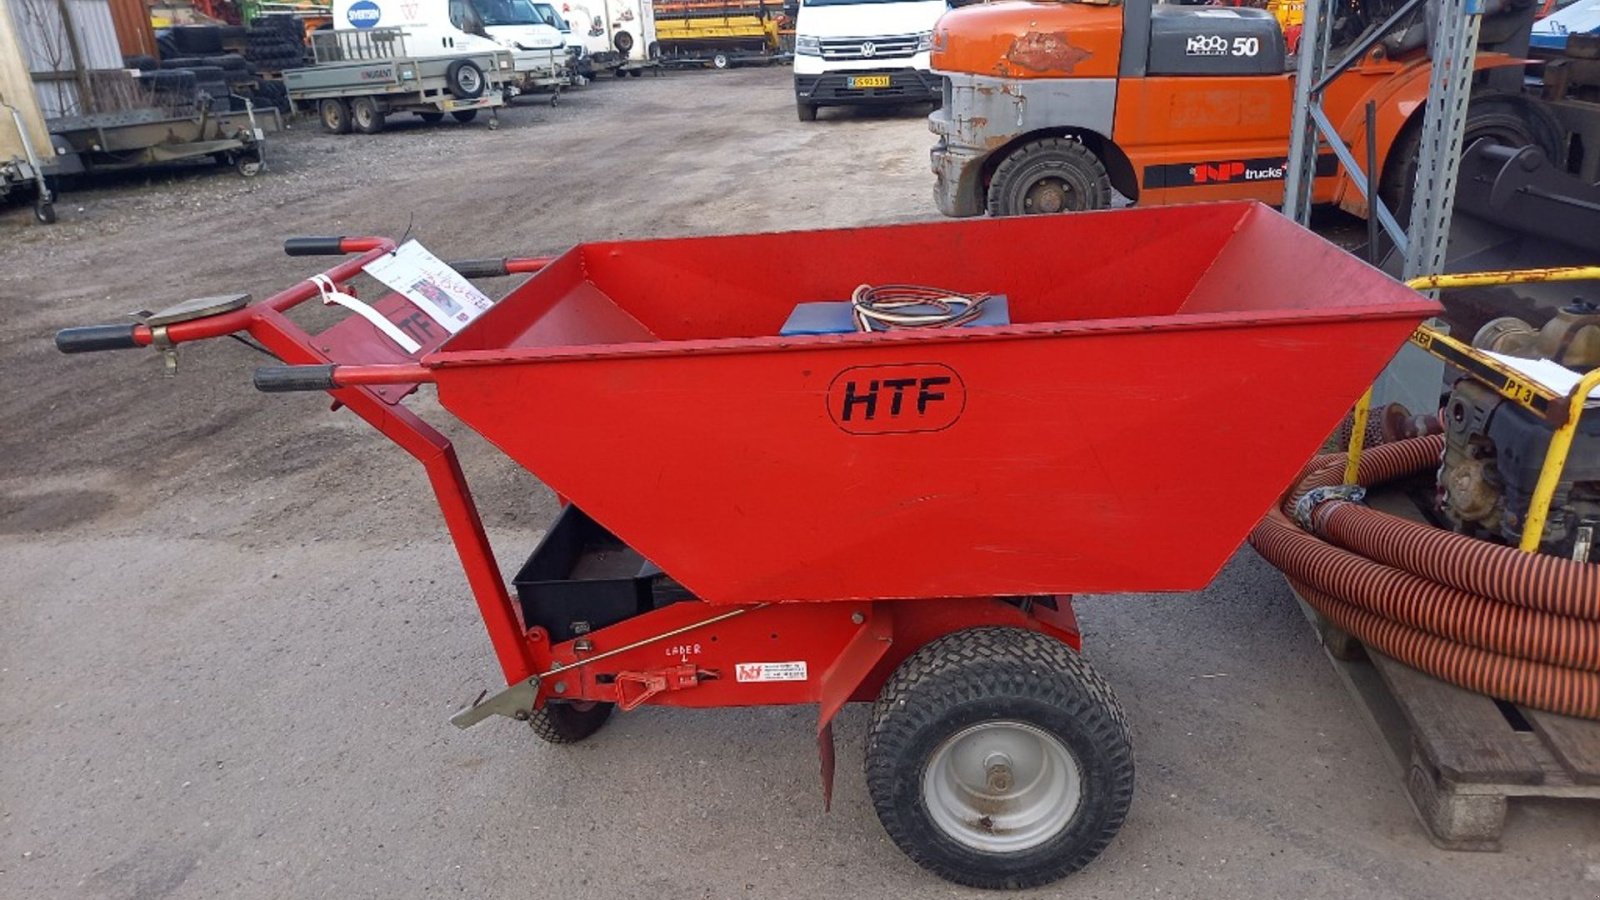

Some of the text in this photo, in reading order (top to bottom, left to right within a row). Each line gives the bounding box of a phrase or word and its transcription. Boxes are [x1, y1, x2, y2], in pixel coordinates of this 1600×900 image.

[1231, 37, 1259, 56] 50
[1245, 167, 1282, 179] trucks
[842, 376, 951, 421] HTF
[1506, 380, 1533, 402] PT 3
[665, 643, 702, 656] LADER
